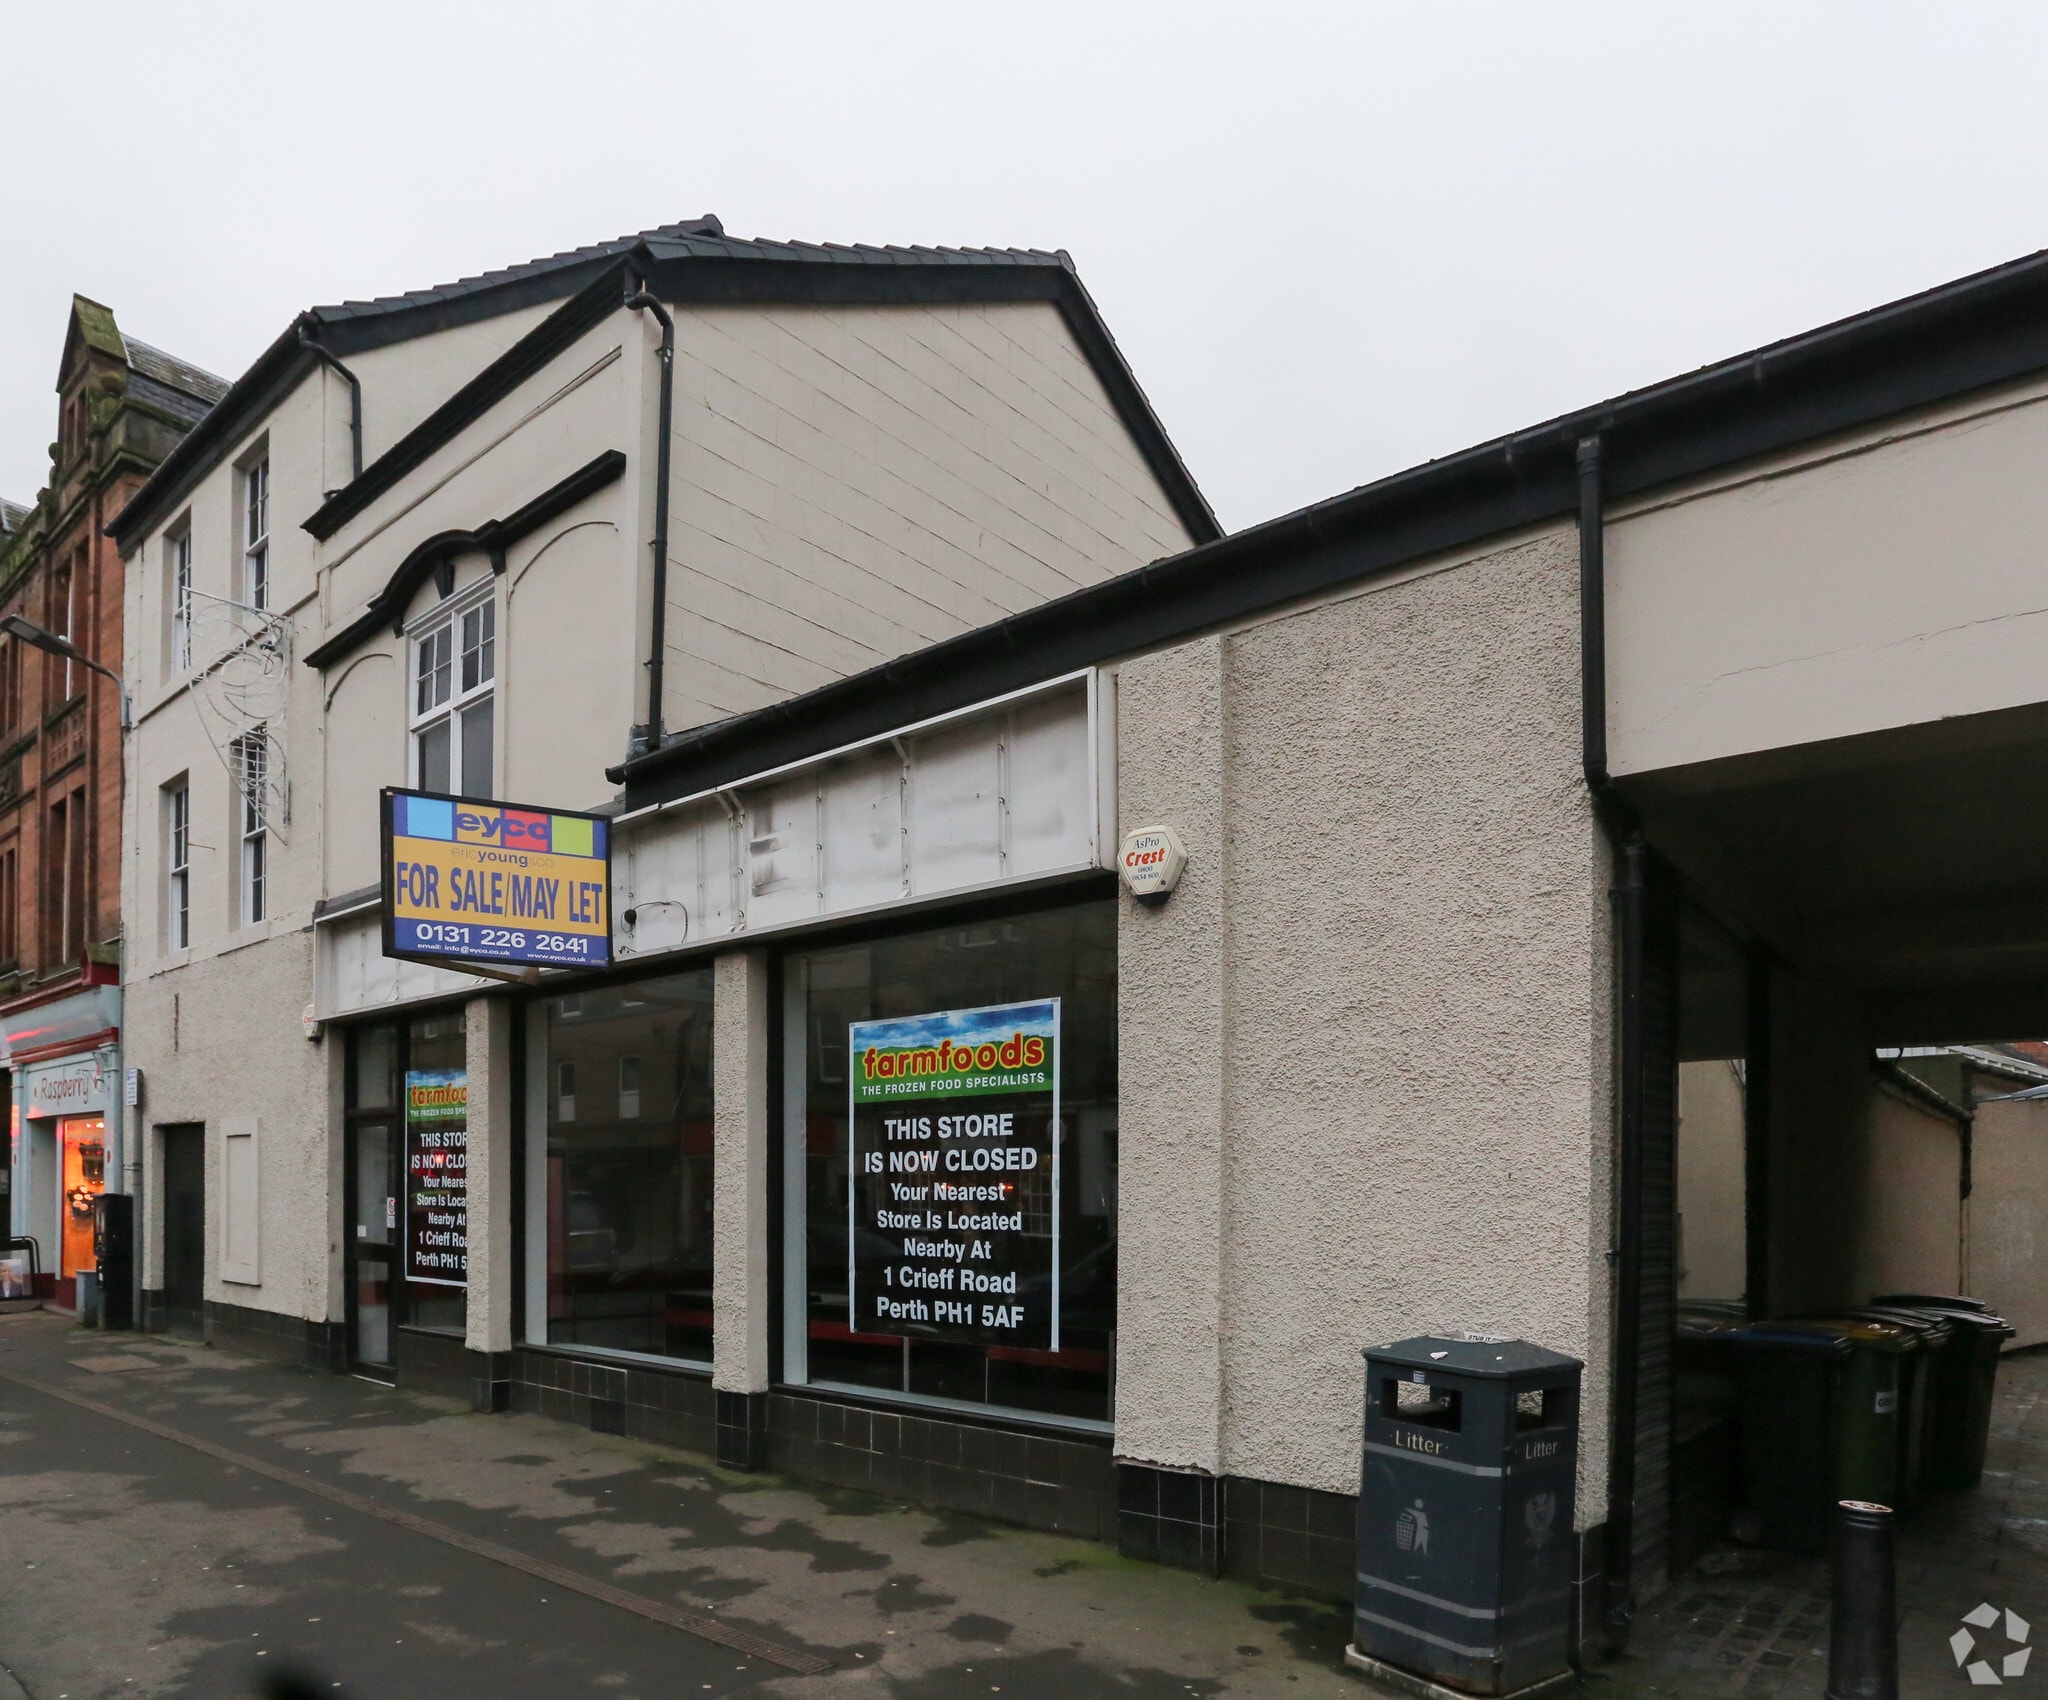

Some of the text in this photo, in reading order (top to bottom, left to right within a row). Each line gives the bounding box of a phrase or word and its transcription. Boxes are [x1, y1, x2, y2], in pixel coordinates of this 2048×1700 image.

[456, 812, 549, 839] eyco
[1133, 837, 1160, 849] AsPro
[1126, 848, 1165, 867] Crest
[397, 862, 440, 909] FOR
[569, 881, 603, 924] LET
[416, 924, 588, 954] 0131 226 2641
[417, 943, 442, 951] email:
[527, 951, 587, 963] www.eyco.co.uk
[863, 1031, 1045, 1079] farmfoods
[41, 1068, 89, 1105] Raspberry
[862, 1072, 1045, 1096] THE FROZEN FOOD SPECIALISTS
[410, 1083, 467, 1108] farmfoo
[440, 1107, 454, 1116] FOOD
[884, 1113, 1014, 1141] THIS STORE
[420, 1132, 467, 1147] THIS STOR
[411, 1153, 467, 1169] IS NOW CLO
[865, 1147, 1038, 1173] IS NOW CLOSED
[423, 1175, 440, 1189] Your
[890, 1182, 1006, 1202] Your Nearest
[416, 1193, 467, 1207] Store Is Loca
[428, 1211, 466, 1228] Nearby At
[877, 1210, 1022, 1231] Store Is Located
[418, 1231, 424, 1245] 1
[426, 1230, 450, 1247] Crieff
[416, 1250, 439, 1267] Perth
[440, 1254, 459, 1270] PH1
[904, 1238, 992, 1263] Nearby At
[884, 1266, 1016, 1294] 1 Crieff Road
[877, 1296, 1024, 1329] Perth PH1 5AF
[1395, 1429, 1443, 1455] Litter
[1525, 1441, 1558, 1460] Litter
